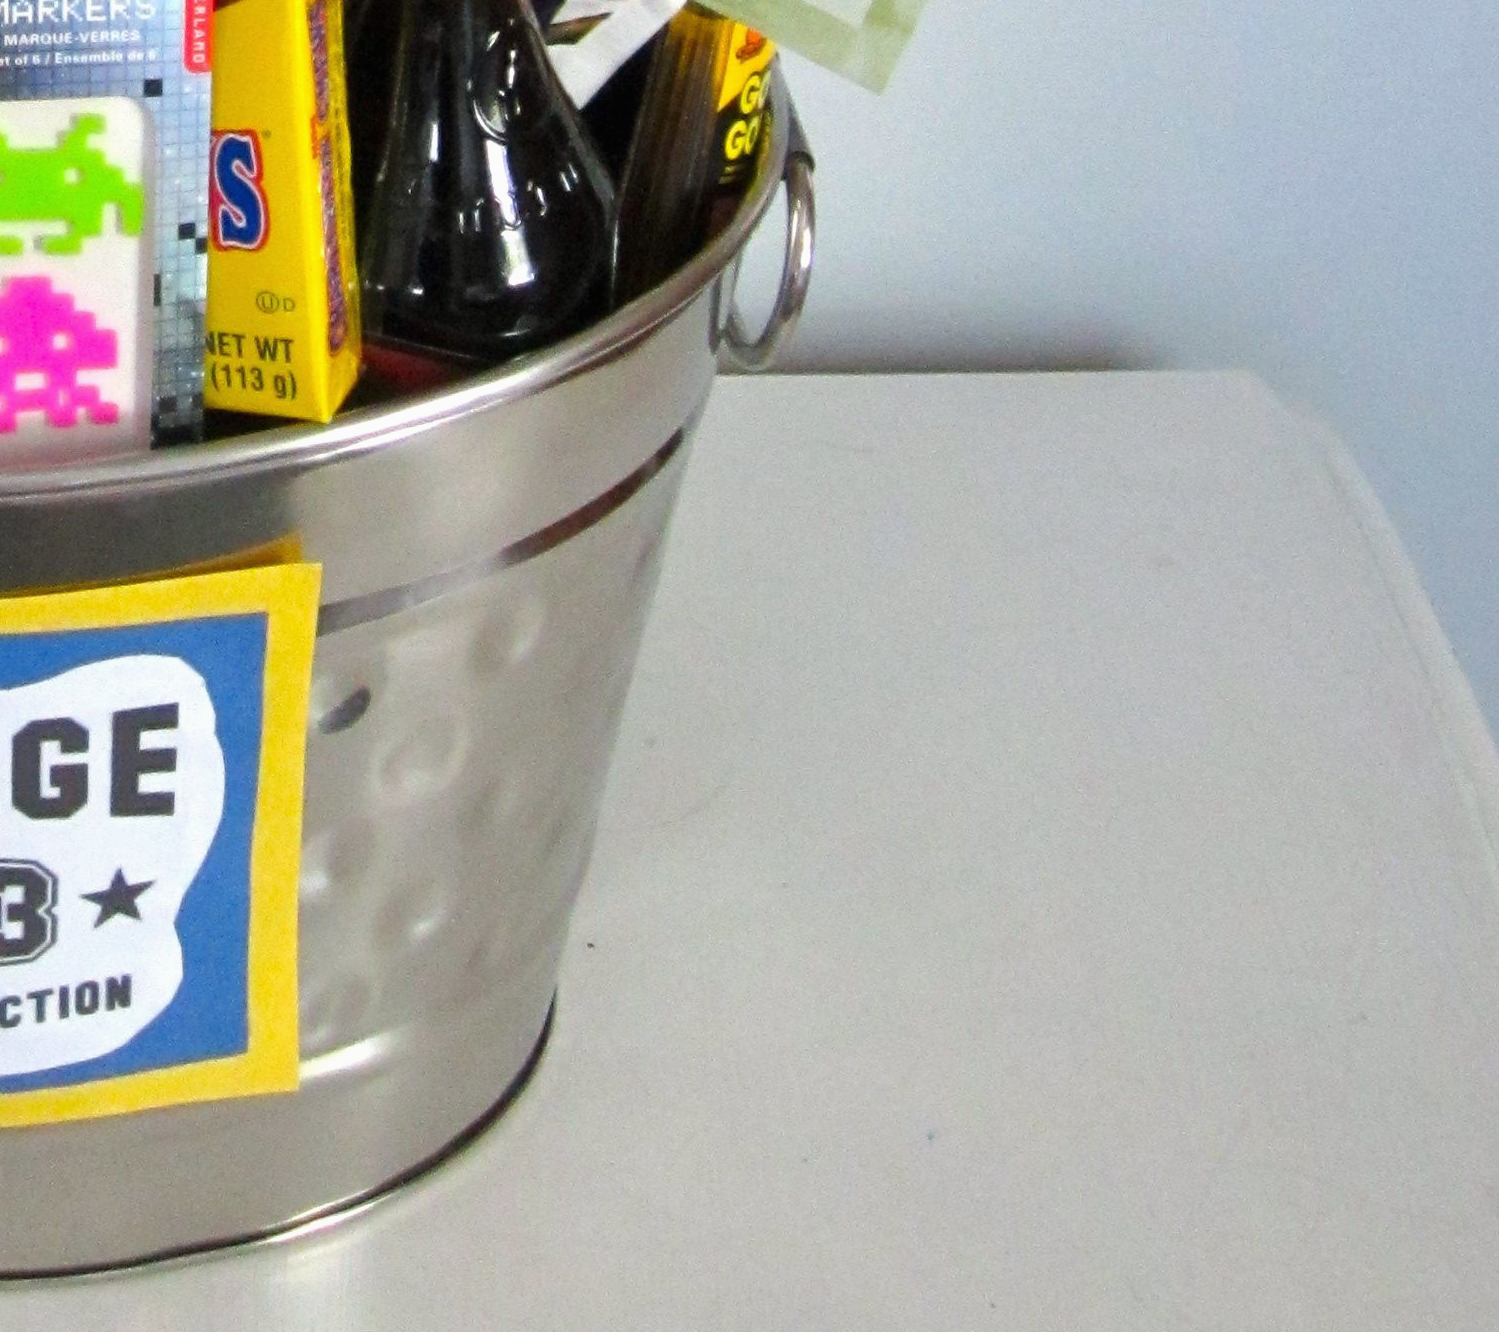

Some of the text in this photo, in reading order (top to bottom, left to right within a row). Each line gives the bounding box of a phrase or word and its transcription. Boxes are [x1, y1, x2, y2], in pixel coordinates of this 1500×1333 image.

[4, 29, 141, 47] MARQUE-VERRES
[16, 53, 30, 66] of
[32, 53, 41, 66] 6
[54, 50, 121, 65] Ensemble
[125, 50, 140, 63] de
[146, 50, 156, 63] 6
[206, 332, 296, 364] NET WT
[211, 362, 298, 400] (113 g)
